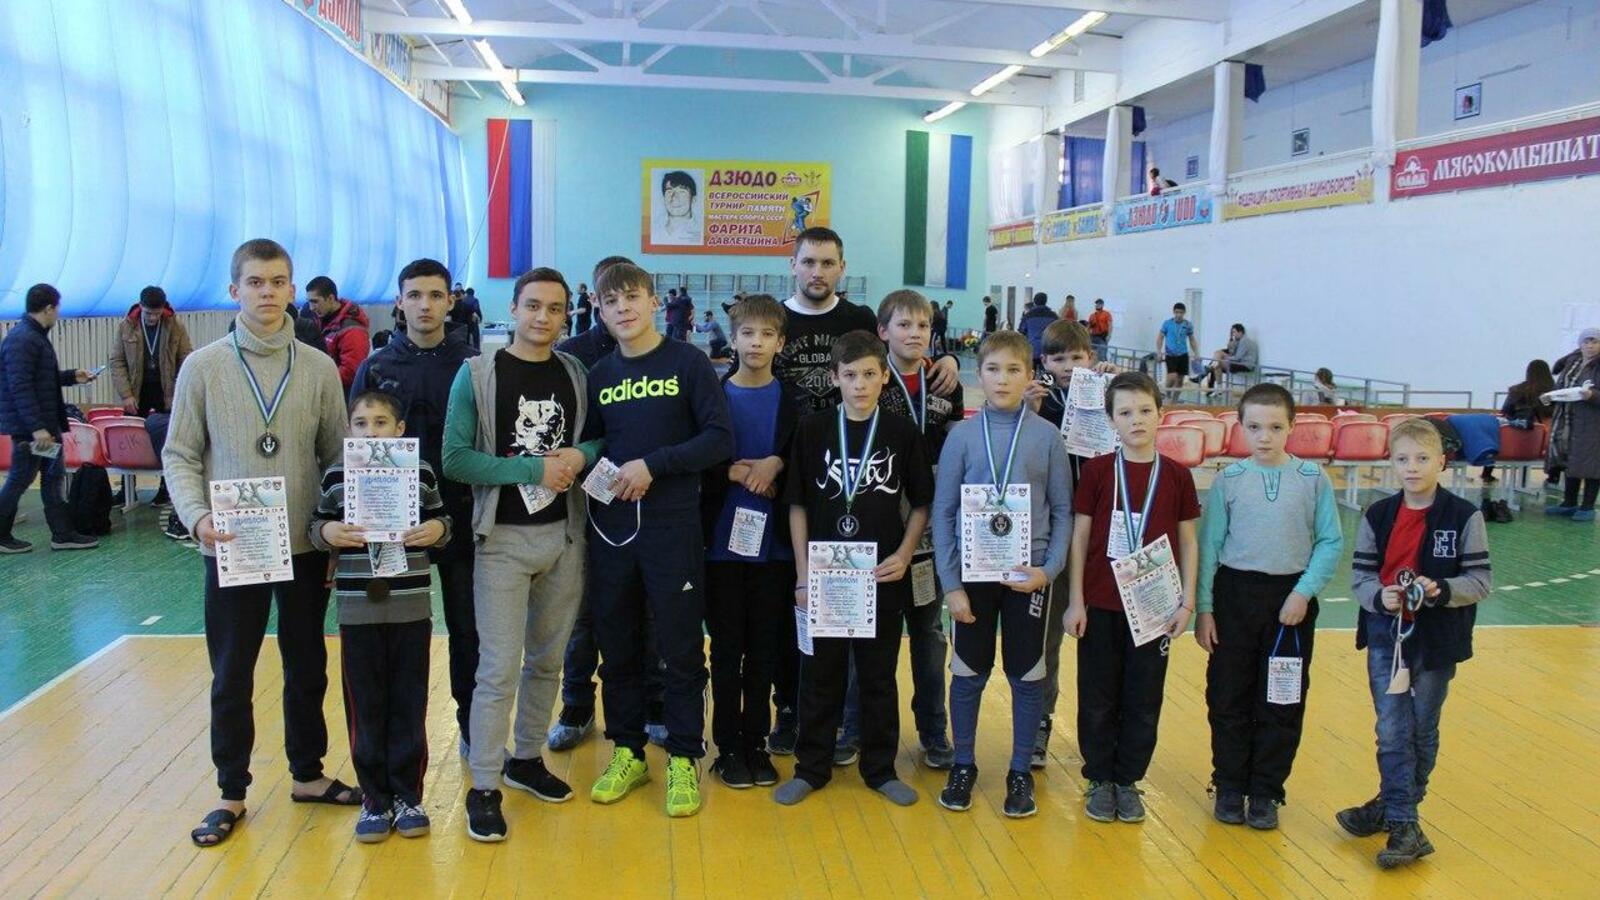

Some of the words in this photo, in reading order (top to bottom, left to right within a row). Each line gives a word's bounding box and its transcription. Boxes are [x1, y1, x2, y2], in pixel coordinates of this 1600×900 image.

[1433, 134, 1600, 181] МЯСОКОМБИНАТ
[709, 170, 777, 187] ДЗЮДО
[709, 192, 789, 201] ВСЕРОССИЙСКИЙ
[710, 202, 745, 210] ТУРНИР
[747, 204, 785, 213] ПАМЯТИ
[709, 224, 762, 235] ФАРИТА
[708, 236, 778, 246] ДАВЛЕТШИНА
[799, 353, 832, 364] GLOBA
[599, 375, 680, 405] adidas
